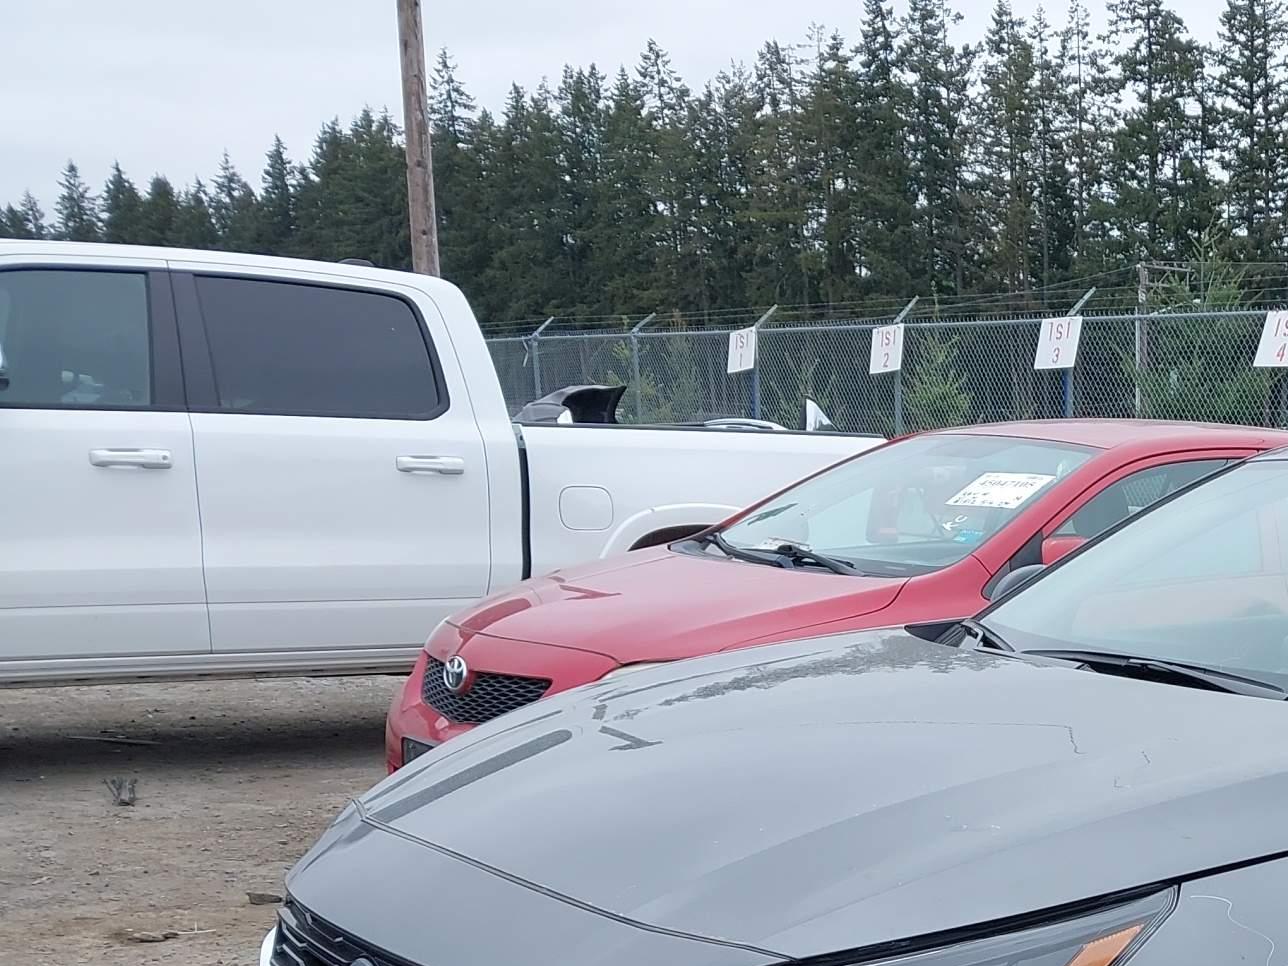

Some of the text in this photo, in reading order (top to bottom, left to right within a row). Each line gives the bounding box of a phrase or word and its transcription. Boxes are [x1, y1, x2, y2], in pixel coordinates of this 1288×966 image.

[882, 352, 889, 368] 2
[1052, 347, 1060, 364] 3
[1276, 343, 1287, 362] 4
